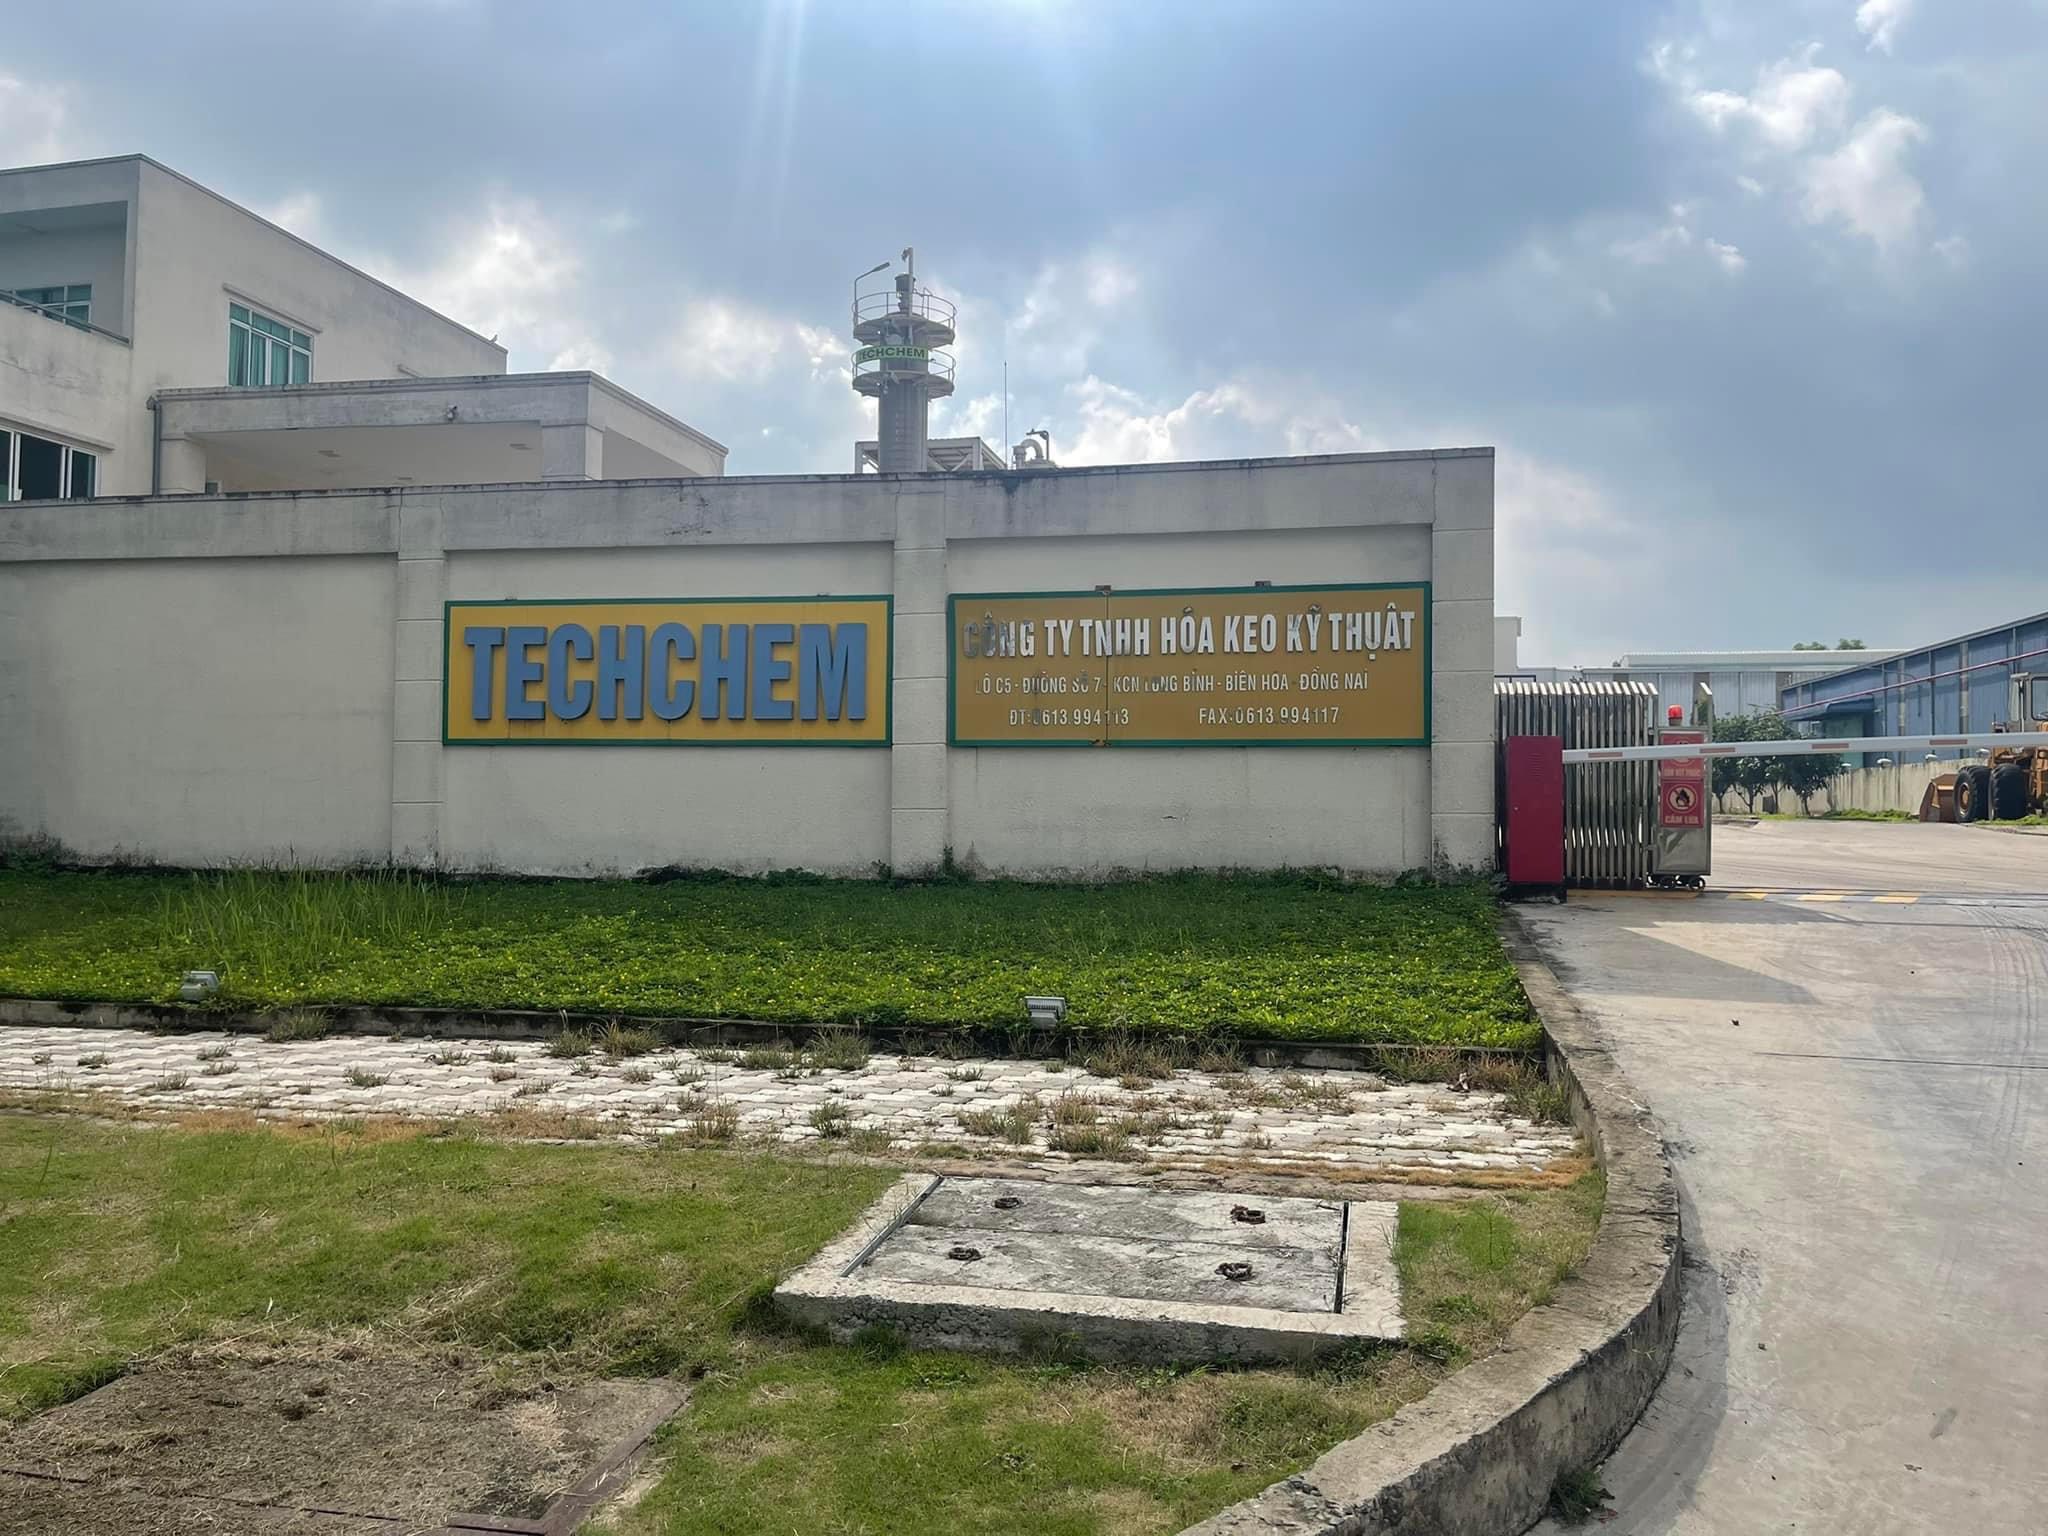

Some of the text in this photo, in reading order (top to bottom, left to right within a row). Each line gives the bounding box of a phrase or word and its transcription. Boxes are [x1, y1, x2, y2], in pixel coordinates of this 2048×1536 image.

[963, 602, 1415, 660] CÔNG TY TNHH HÓA KEO KỸ THUẬT
[464, 622, 868, 721] TECHCHEM
[996, 677, 1012, 694] C5
[1113, 676, 1139, 693] KCN
